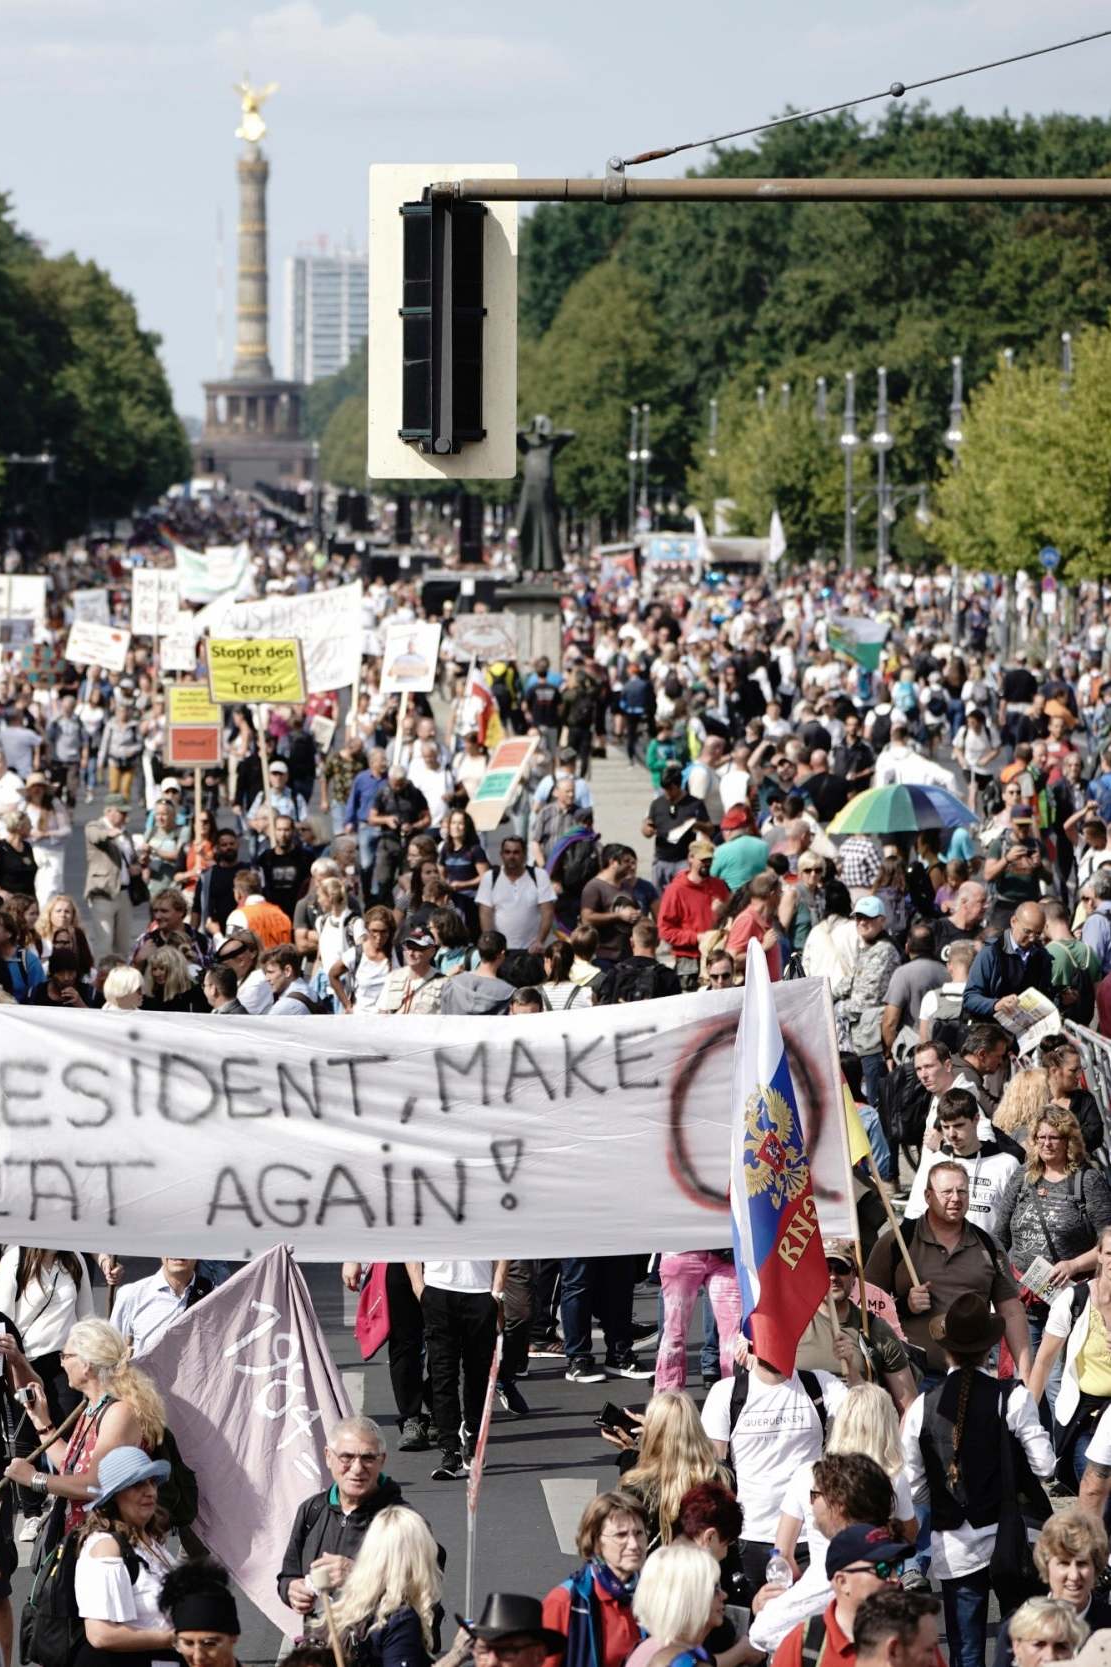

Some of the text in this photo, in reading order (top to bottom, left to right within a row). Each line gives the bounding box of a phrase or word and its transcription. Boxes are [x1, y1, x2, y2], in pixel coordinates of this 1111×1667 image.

[212, 644, 294, 660] Stoppt den
[241, 664, 279, 677] Test-
[434, 1025, 660, 1113] MAKE
